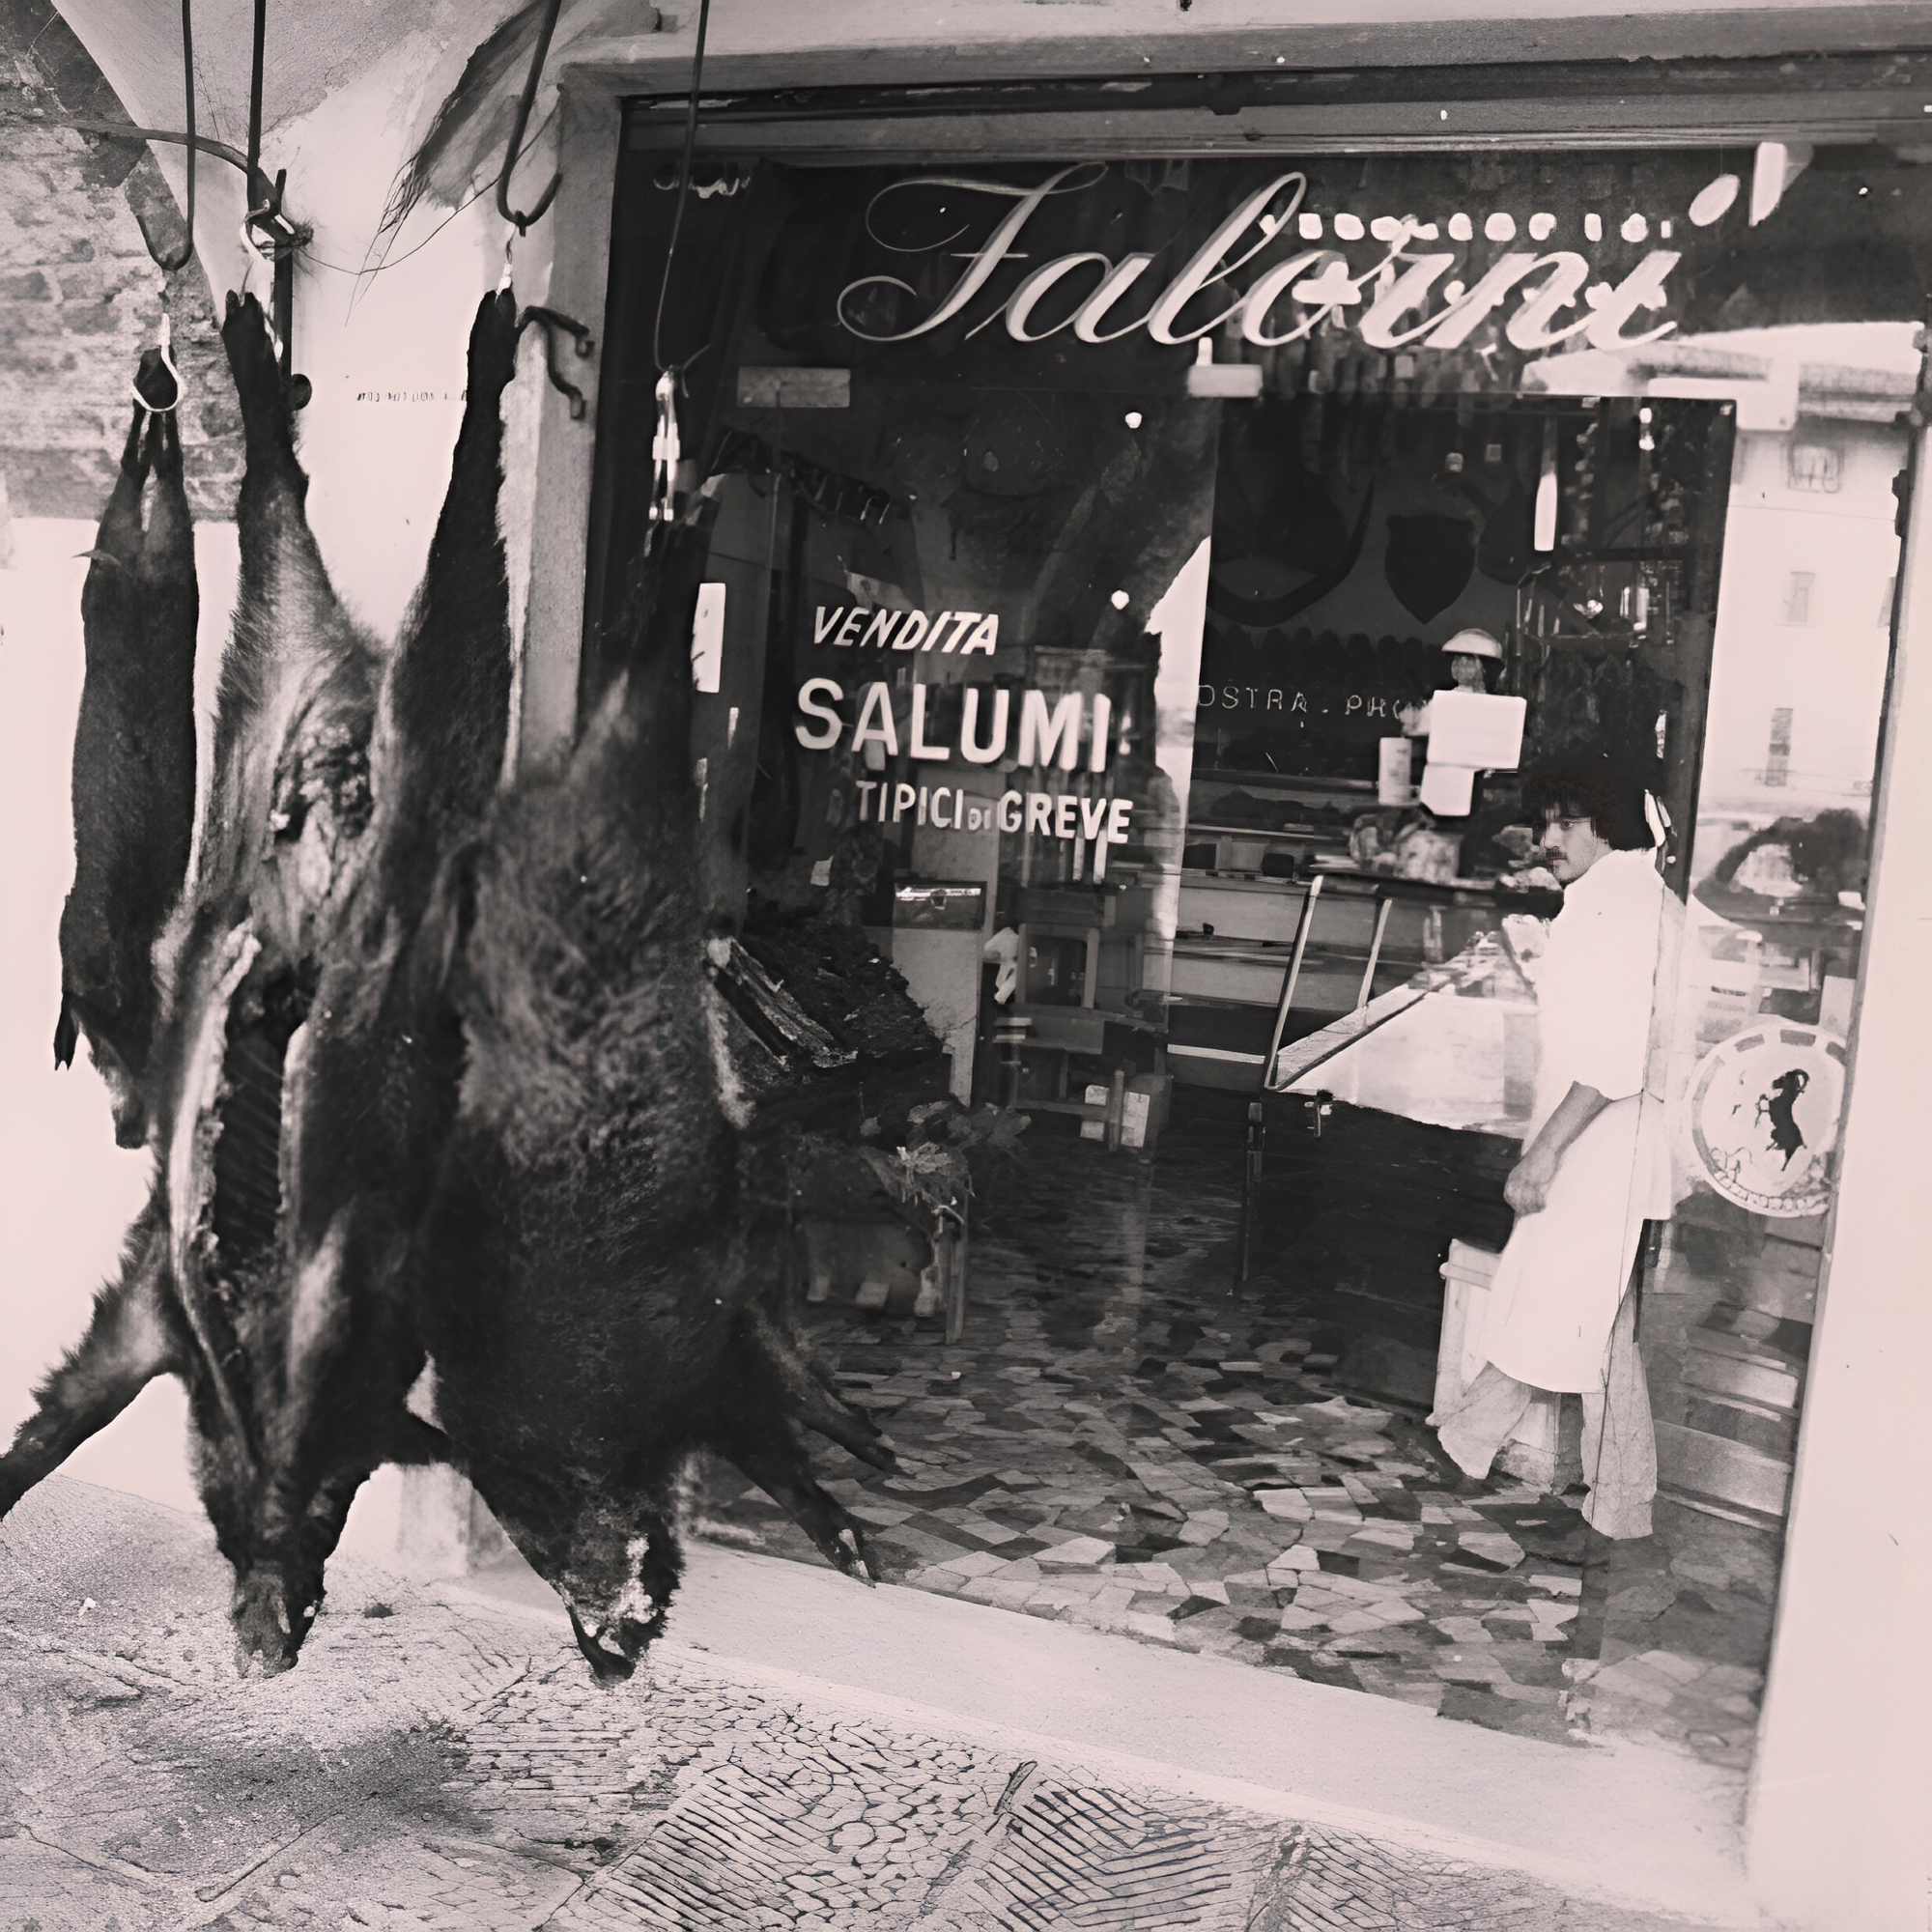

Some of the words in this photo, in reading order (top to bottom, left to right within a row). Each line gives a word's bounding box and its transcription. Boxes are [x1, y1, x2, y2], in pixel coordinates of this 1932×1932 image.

[837, 161, 1738, 350] Falorni
[813, 606, 999, 655] VENDITA
[795, 678, 1111, 772] SALUMI
[856, 781, 963, 830] TIPICI
[999, 790, 1133, 843] GREVE
